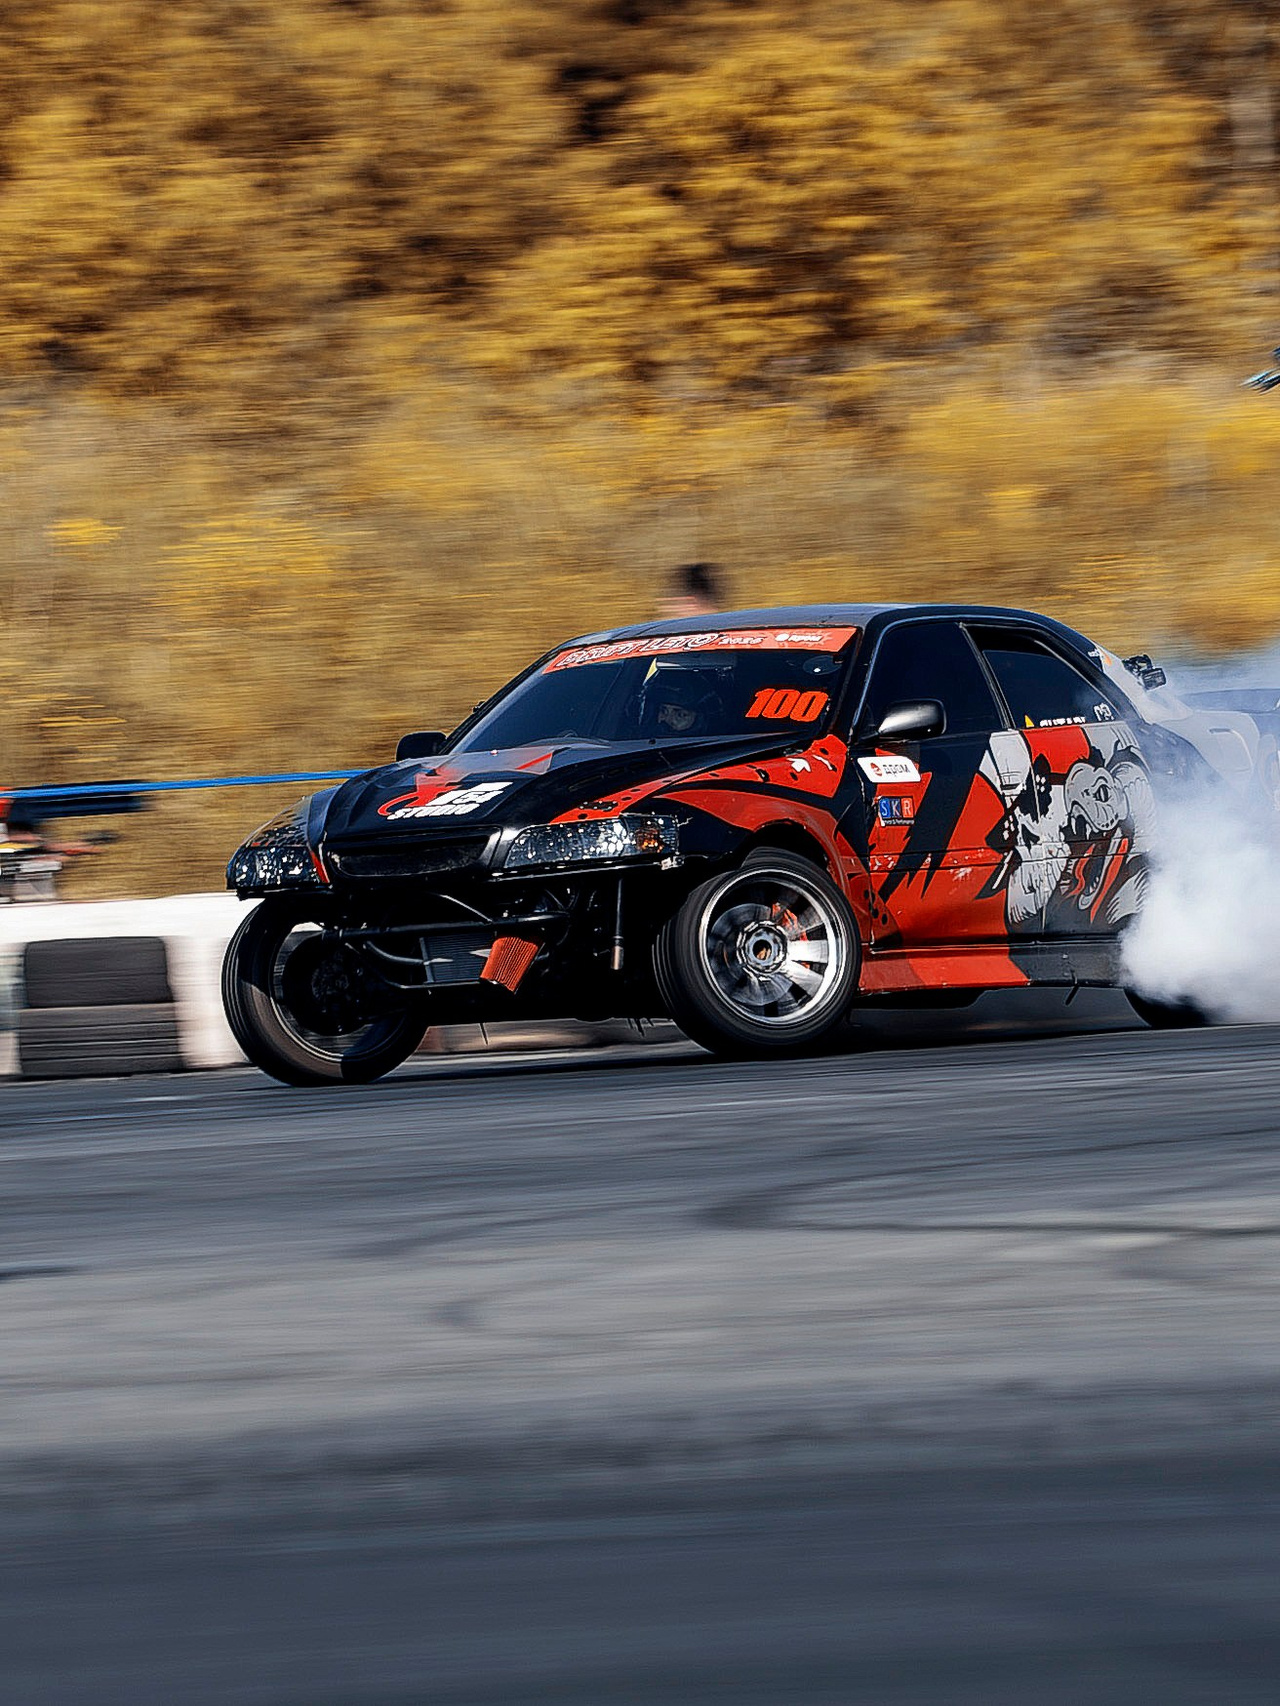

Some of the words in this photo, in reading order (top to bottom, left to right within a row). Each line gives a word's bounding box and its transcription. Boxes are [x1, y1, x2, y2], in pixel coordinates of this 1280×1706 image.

[745, 687, 830, 722] 100
[386, 803, 481, 820] STUDIO
[881, 799, 913, 817] SKR
